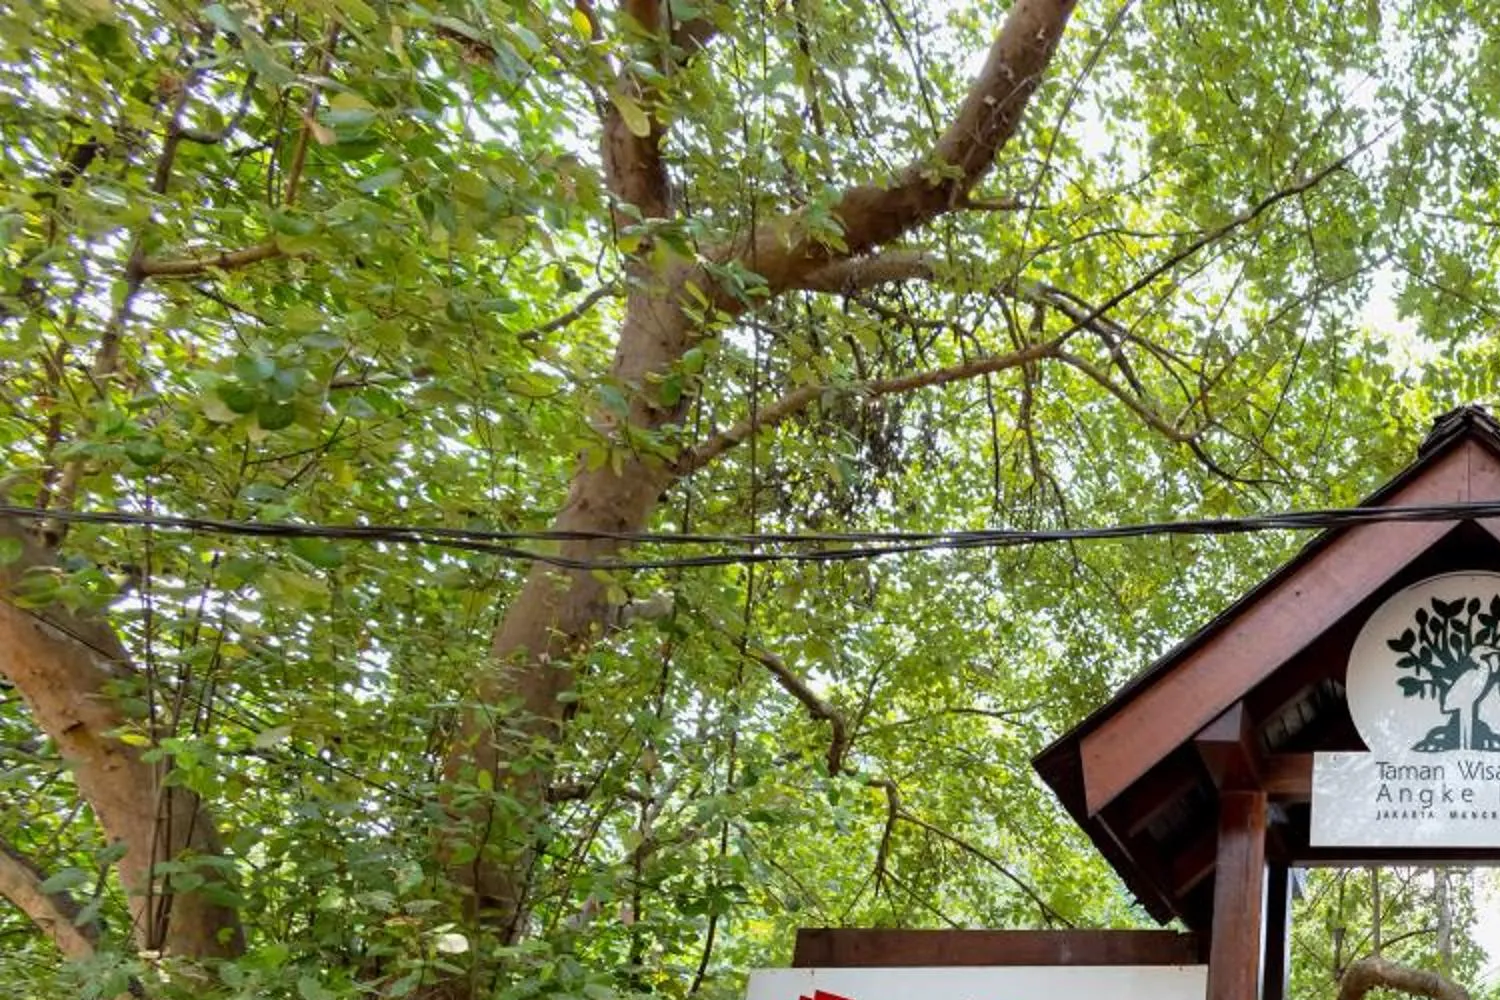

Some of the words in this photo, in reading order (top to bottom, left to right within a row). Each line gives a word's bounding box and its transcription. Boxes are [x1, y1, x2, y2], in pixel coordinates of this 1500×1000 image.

[1375, 761, 1445, 780] Taman
[1375, 783, 1474, 809] Angke
[1375, 810, 1435, 821] JAKARTA
